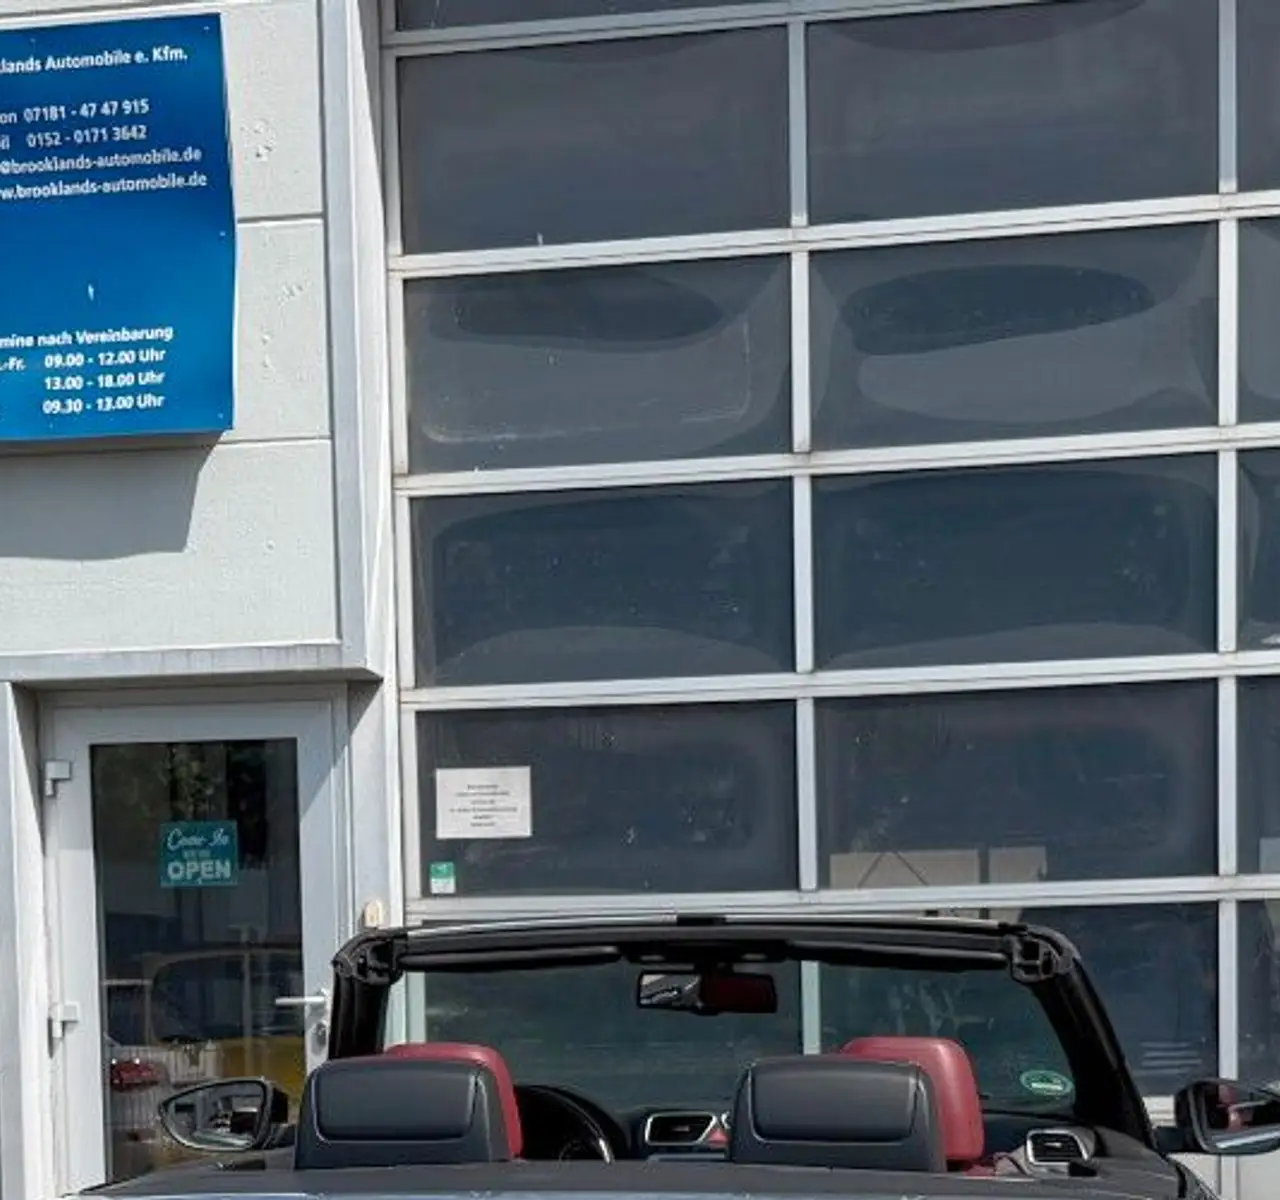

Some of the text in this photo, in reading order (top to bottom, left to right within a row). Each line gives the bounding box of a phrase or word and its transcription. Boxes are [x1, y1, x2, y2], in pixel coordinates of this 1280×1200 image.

[45, 50, 131, 70] Automobile
[134, 51, 149, 63] e.
[153, 46, 188, 62] Kfm.
[23, 105, 66, 124] 07181
[79, 102, 97, 118] 47
[100, 101, 118, 117] 47
[122, 99, 150, 115] 915
[28, 132, 62, 148] 0152
[74, 128, 108, 144] 0171
[38, 331, 72, 346] nach
[76, 326, 174, 345] Vereinbarung
[44, 352, 84, 368] 09.00
[98, 351, 136, 366] 12.00
[139, 348, 166, 363] Uhr
[45, 376, 84, 390] 13.00
[97, 373, 135, 388] 18.00
[138, 371, 165, 385] Uhr
[42, 399, 82, 414] 09.30
[137, 394, 165, 409] Uhr
[167, 860, 231, 881] OPEN
